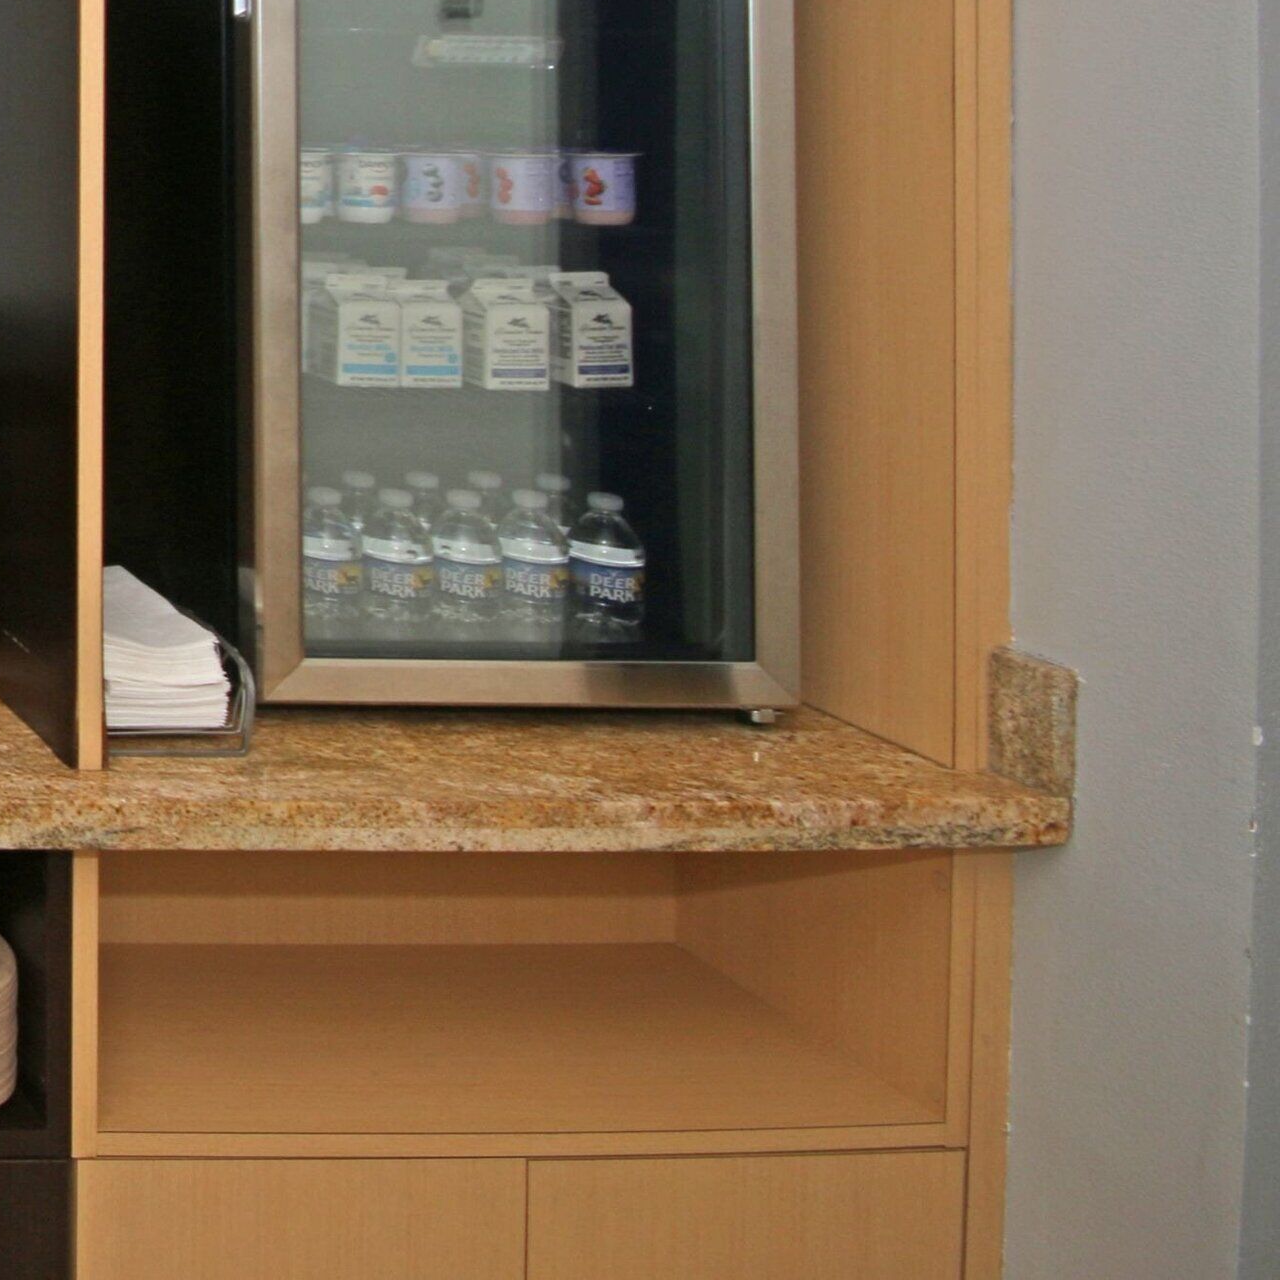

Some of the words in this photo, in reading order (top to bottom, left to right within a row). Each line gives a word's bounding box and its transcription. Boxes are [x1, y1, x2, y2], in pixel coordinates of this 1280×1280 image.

[371, 568, 414, 583] DEER
[442, 567, 485, 585] DEER
[505, 568, 550, 585] DEER
[591, 572, 635, 589] DEER
[371, 580, 416, 599] PARK
[442, 581, 485, 599] PARK
[505, 581, 551, 599] PARK
[590, 585, 635, 602] PARK
